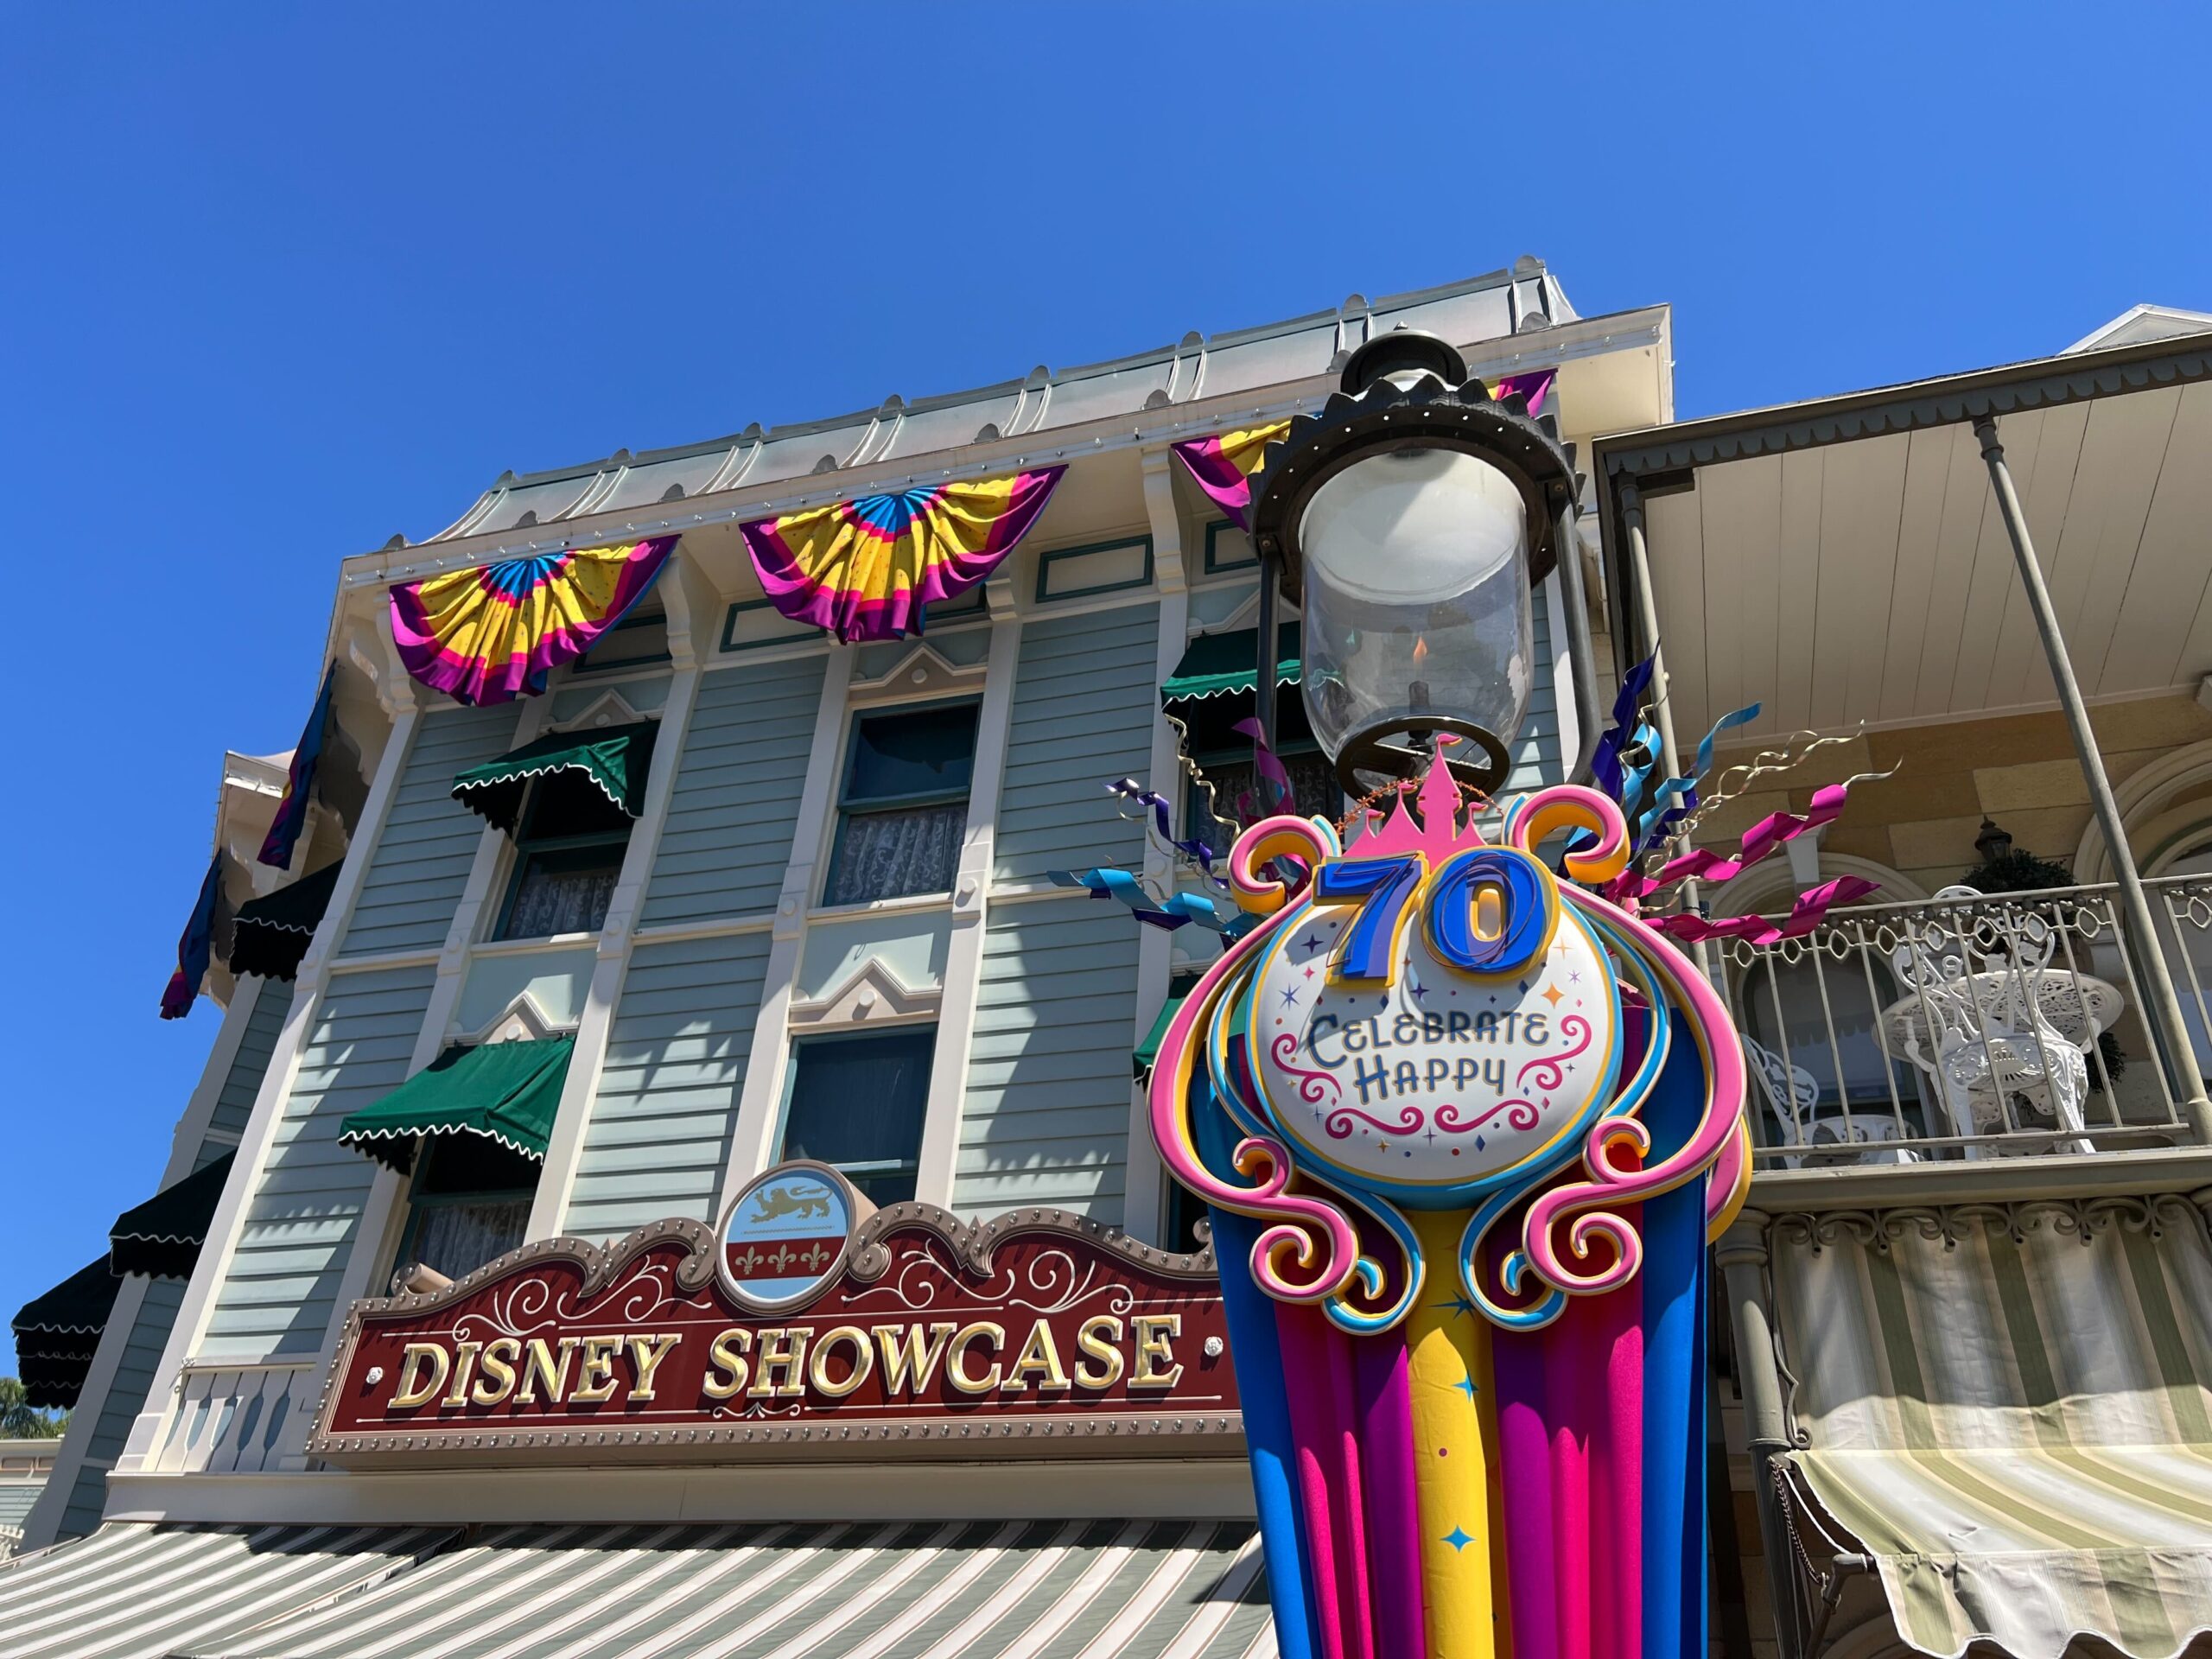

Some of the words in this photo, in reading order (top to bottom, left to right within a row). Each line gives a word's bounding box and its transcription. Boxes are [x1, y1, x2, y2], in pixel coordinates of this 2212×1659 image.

[1312, 845, 1561, 988] 70
[1306, 1011, 1551, 1069] CELEBRATE
[1353, 1053, 1507, 1105] HAPPY
[387, 1333, 683, 1409] DISNEY
[702, 1313, 1185, 1400] SHOWCASE
